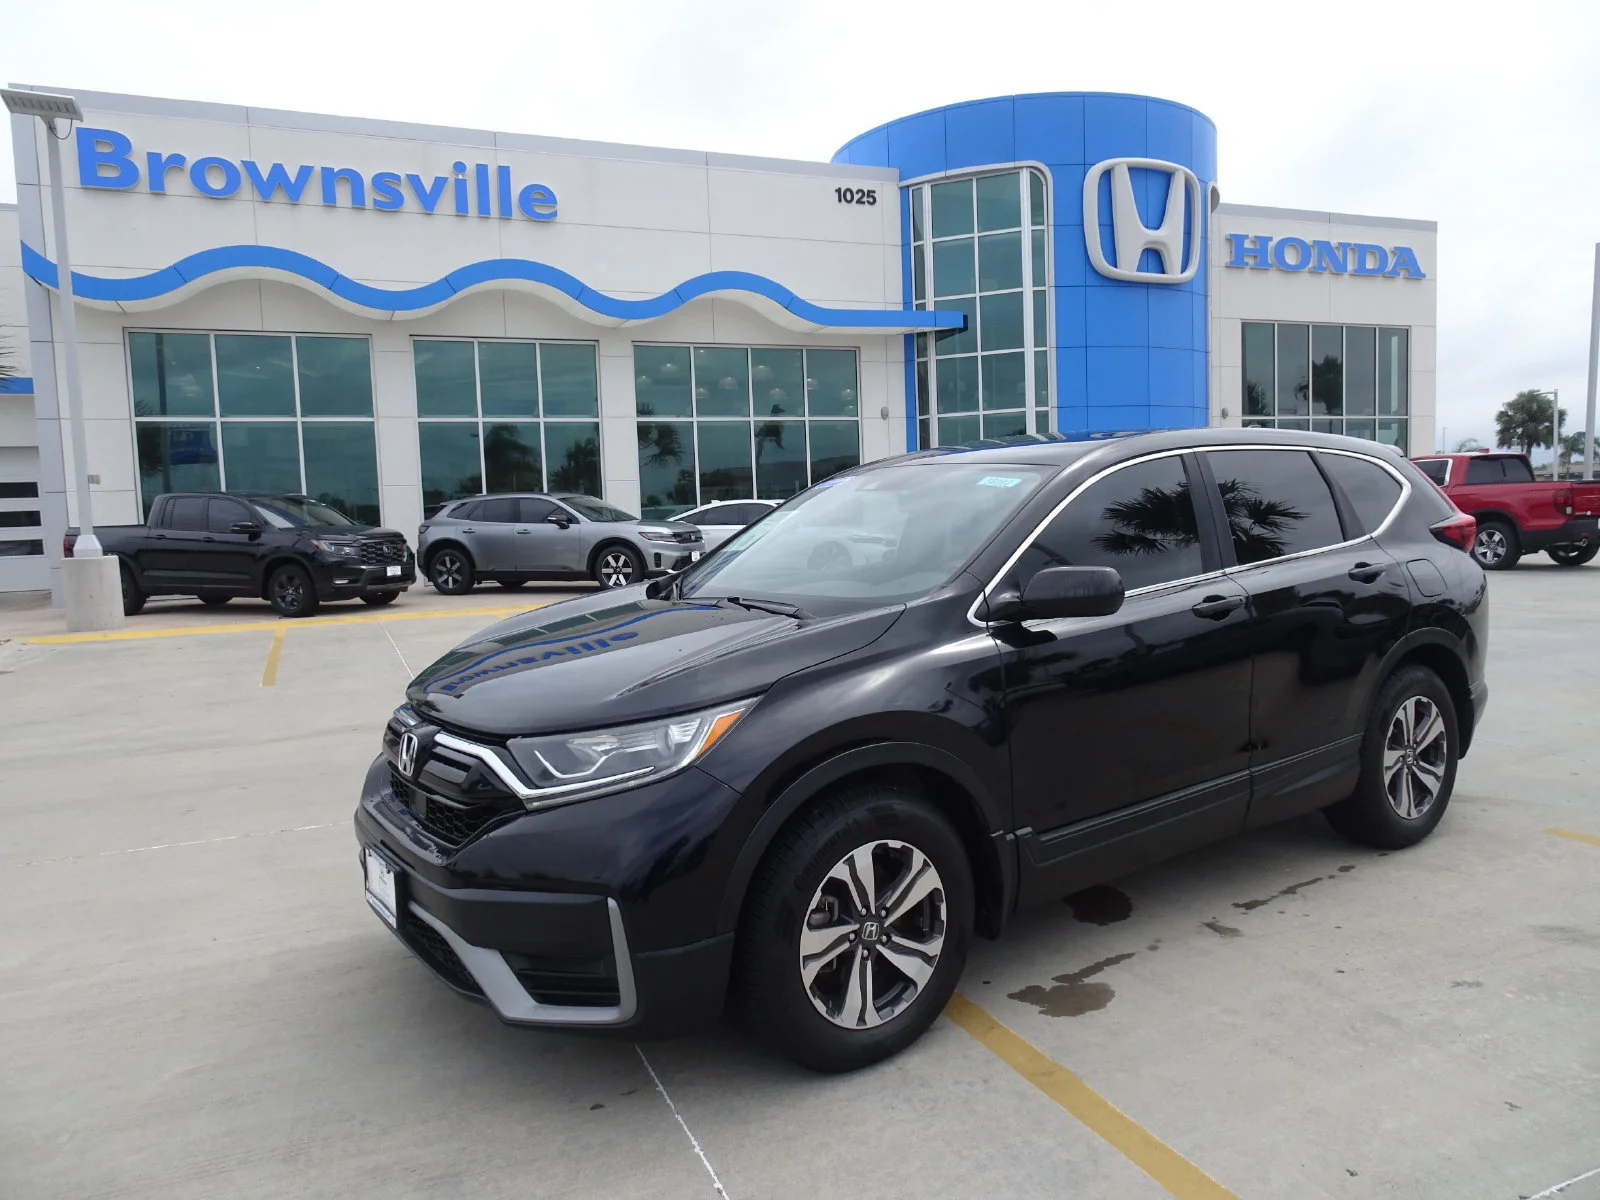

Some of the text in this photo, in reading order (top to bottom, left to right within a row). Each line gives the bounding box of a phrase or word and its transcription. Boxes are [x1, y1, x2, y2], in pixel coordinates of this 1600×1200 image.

[75, 126, 558, 221] Brownsville
[834, 187, 877, 206] 1025
[1226, 233, 1426, 279] HONDA
